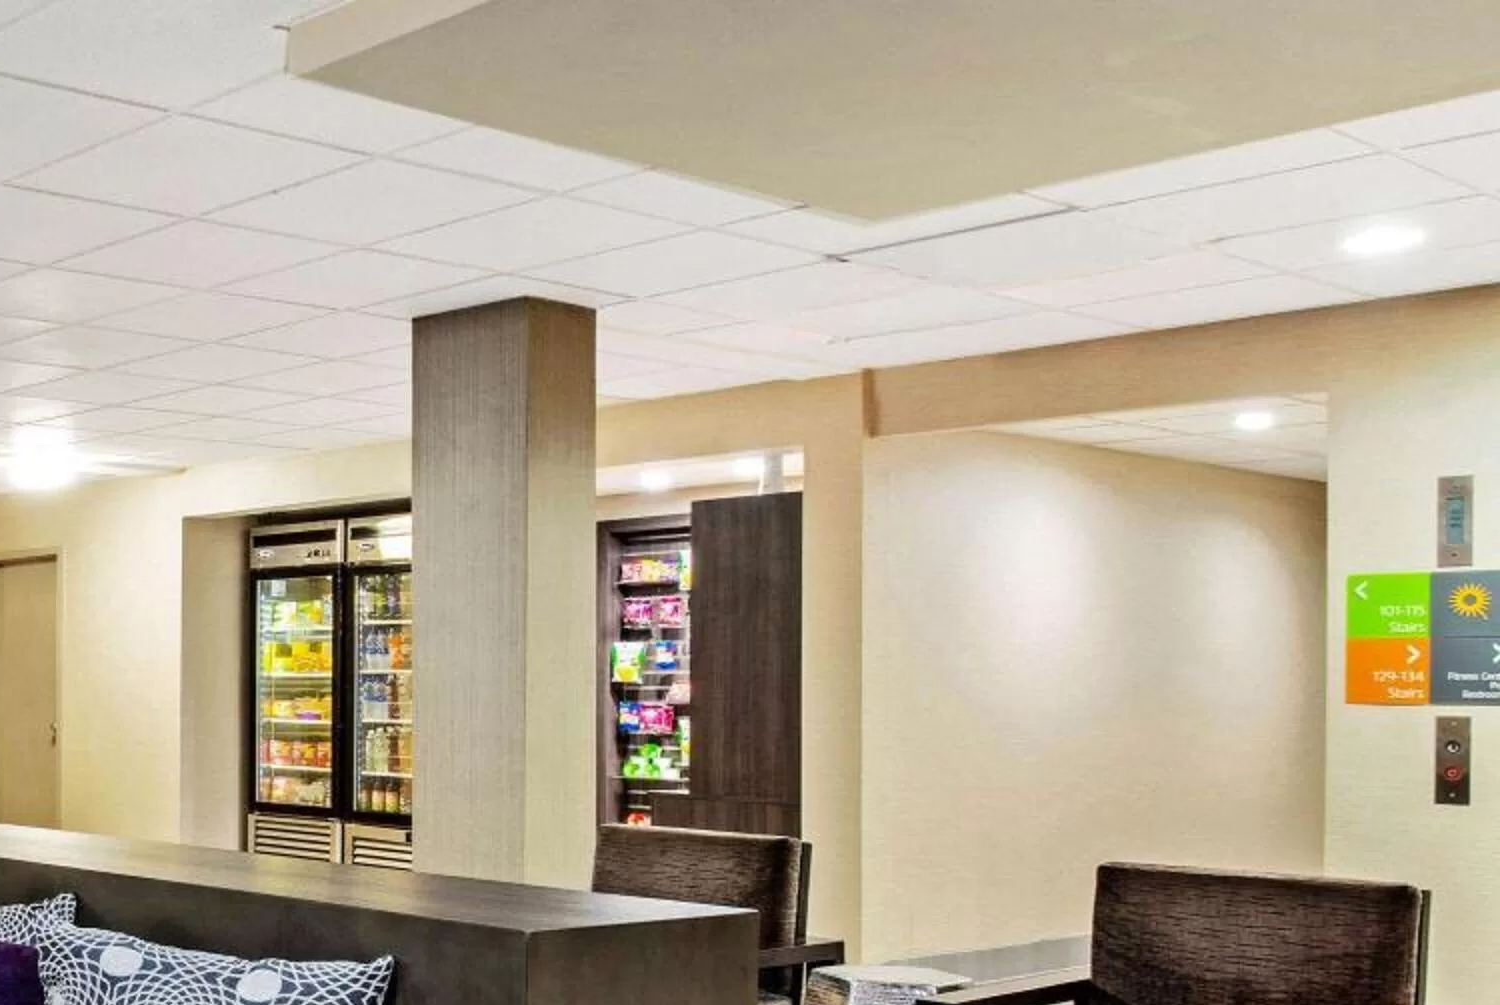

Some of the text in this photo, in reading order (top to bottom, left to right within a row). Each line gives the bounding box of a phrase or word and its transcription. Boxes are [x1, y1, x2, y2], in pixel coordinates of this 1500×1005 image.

[1387, 621, 1428, 634] Stairs
[1447, 671, 1479, 681] Fitness
[1387, 687, 1425, 699] Stairs
